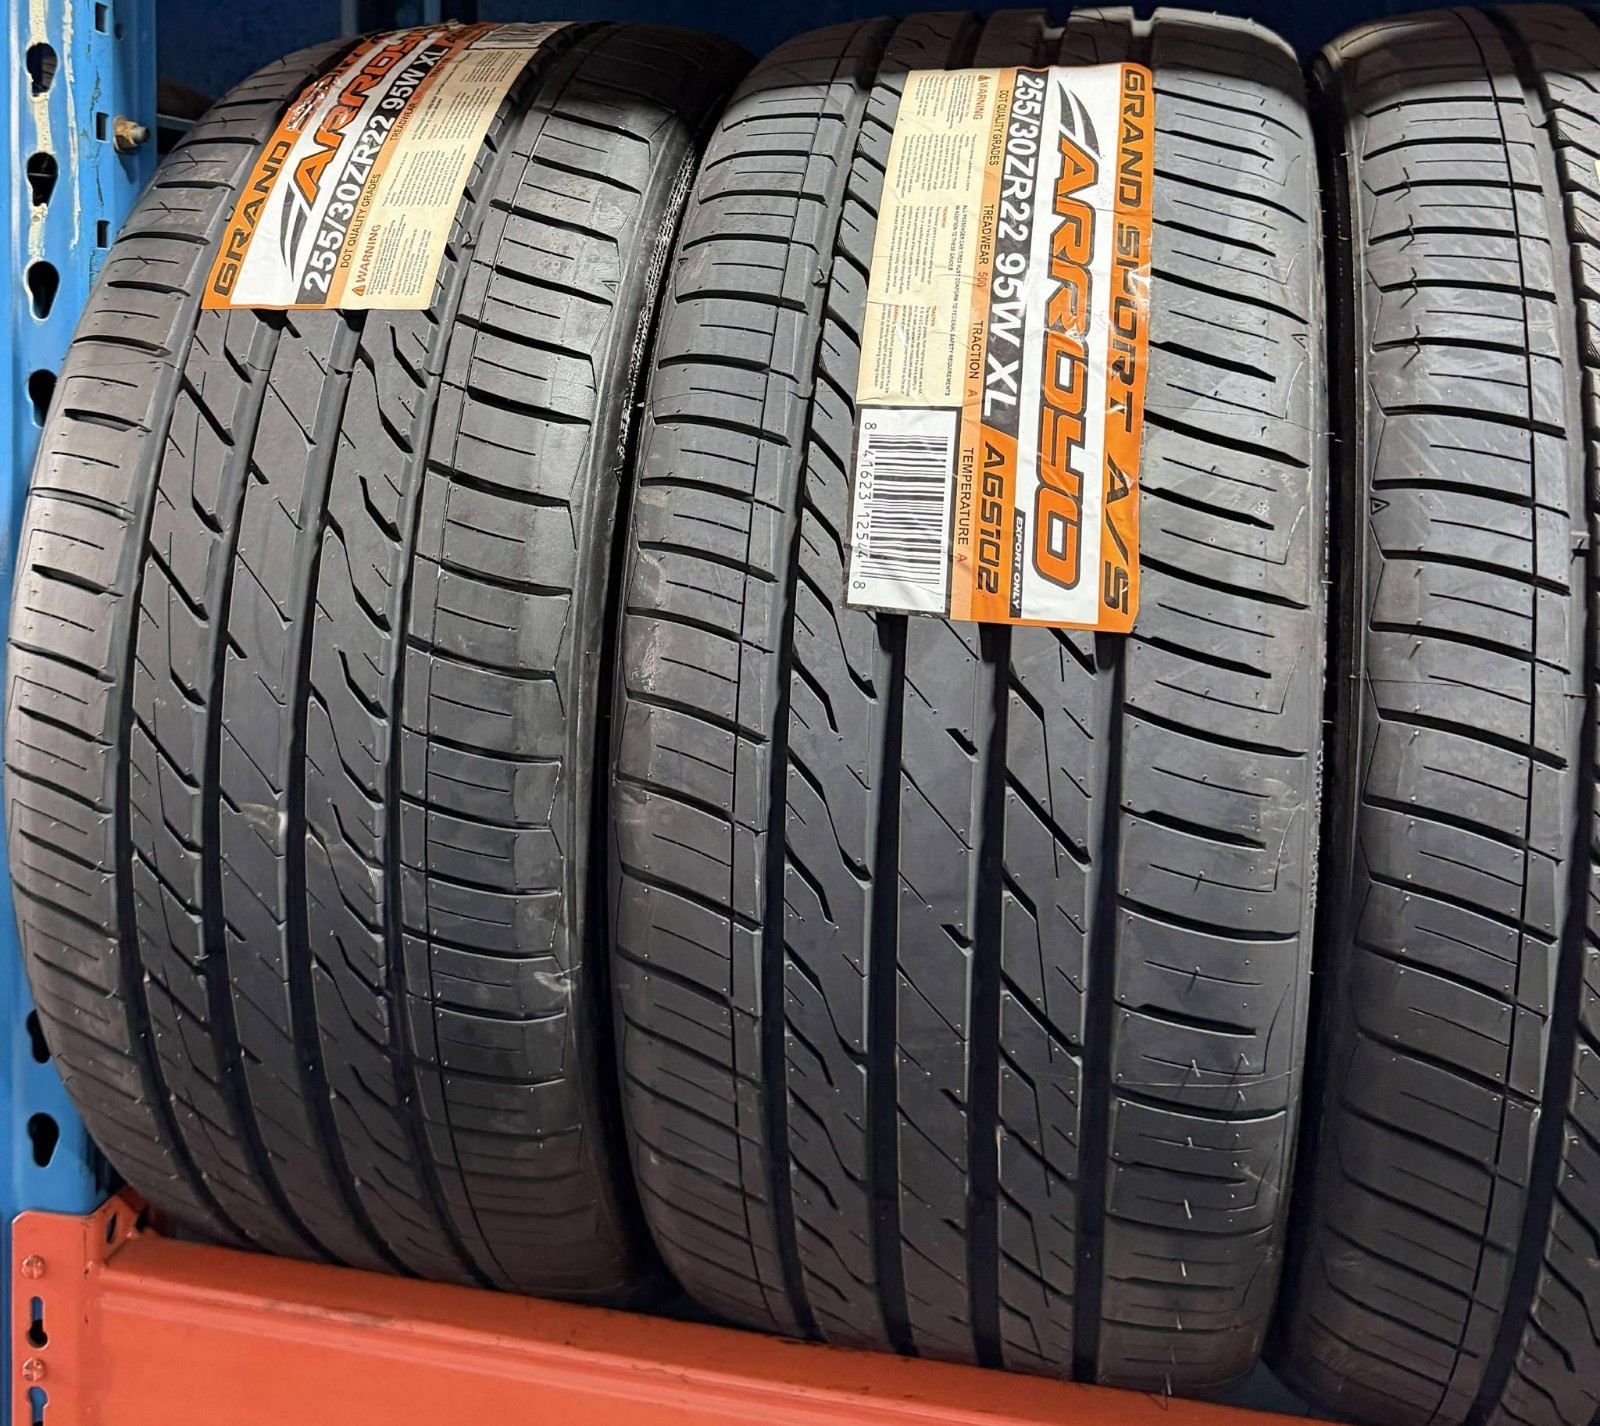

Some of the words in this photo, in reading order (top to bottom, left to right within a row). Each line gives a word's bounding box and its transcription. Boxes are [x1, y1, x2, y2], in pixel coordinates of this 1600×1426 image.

[390, 102, 418, 141] TREADWEAR
[973, 82, 989, 120] WARNING
[994, 104, 1007, 133] QUALITY
[999, 90, 1009, 103] DOT
[989, 134, 1002, 166] GRADES
[997, 74, 1044, 241] 255/30ZR22
[1118, 69, 1145, 208] GRAND
[304, 114, 395, 294] 255/30ZR22
[381, 66, 427, 110] 95W
[413, 47, 449, 67] XL
[213, 140, 292, 296] GRAND
[340, 249, 353, 268] DOT
[348, 209, 367, 247] QUALITY
[362, 174, 381, 207] GRADES
[979, 204, 994, 264] TREADWEAR
[356, 224, 381, 283] WARNING
[977, 272, 988, 287] 500
[990, 253, 1026, 348] 95W
[1110, 222, 1139, 432] SPORT
[969, 321, 983, 379] TRACTION
[1032, 130, 1099, 590] ARROYO
[968, 389, 978, 397] A
[983, 352, 1020, 417] XL
[864, 422, 877, 430] 8
[859, 450, 875, 500] 41623
[958, 448, 974, 545] TEMPERATURE
[856, 512, 870, 559] 12544
[978, 441, 1004, 594] AGS102
[1014, 517, 1023, 570] EXPORT
[1104, 453, 1129, 615] A/S
[853, 581, 866, 589] 8
[957, 553, 968, 563] A
[1012, 572, 1021, 609] ONLY
